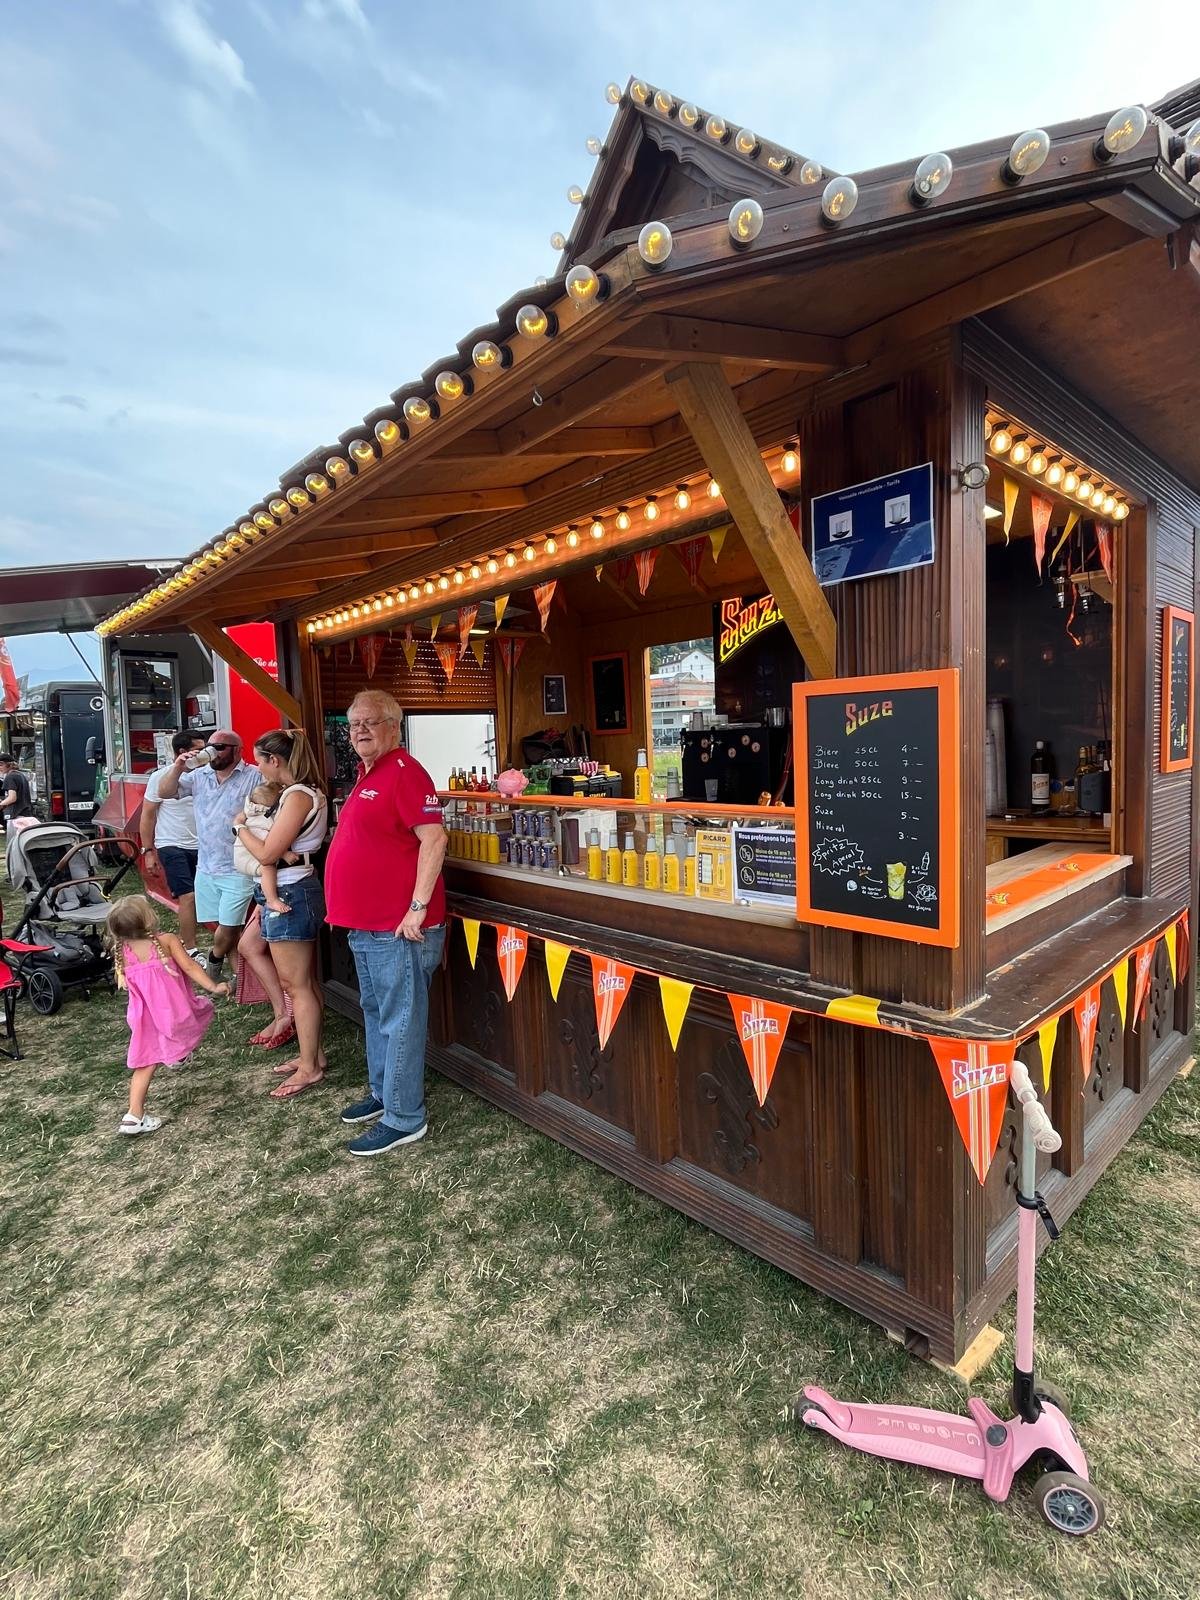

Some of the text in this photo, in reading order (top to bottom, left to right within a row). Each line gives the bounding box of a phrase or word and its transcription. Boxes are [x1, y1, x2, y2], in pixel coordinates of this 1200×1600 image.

[845, 700, 894, 737] Suze
[815, 775, 835, 788] Long
[814, 789, 833, 800] Long
[836, 791, 858, 799] drink
[703, 834, 727, 843] RICARD
[815, 842, 846, 861] Spritz
[831, 849, 857, 869] Aperol
[500, 936, 525, 957] Suze
[597, 971, 626, 996] Suze
[742, 1011, 779, 1040] Suze
[952, 1060, 1006, 1098] Suze
